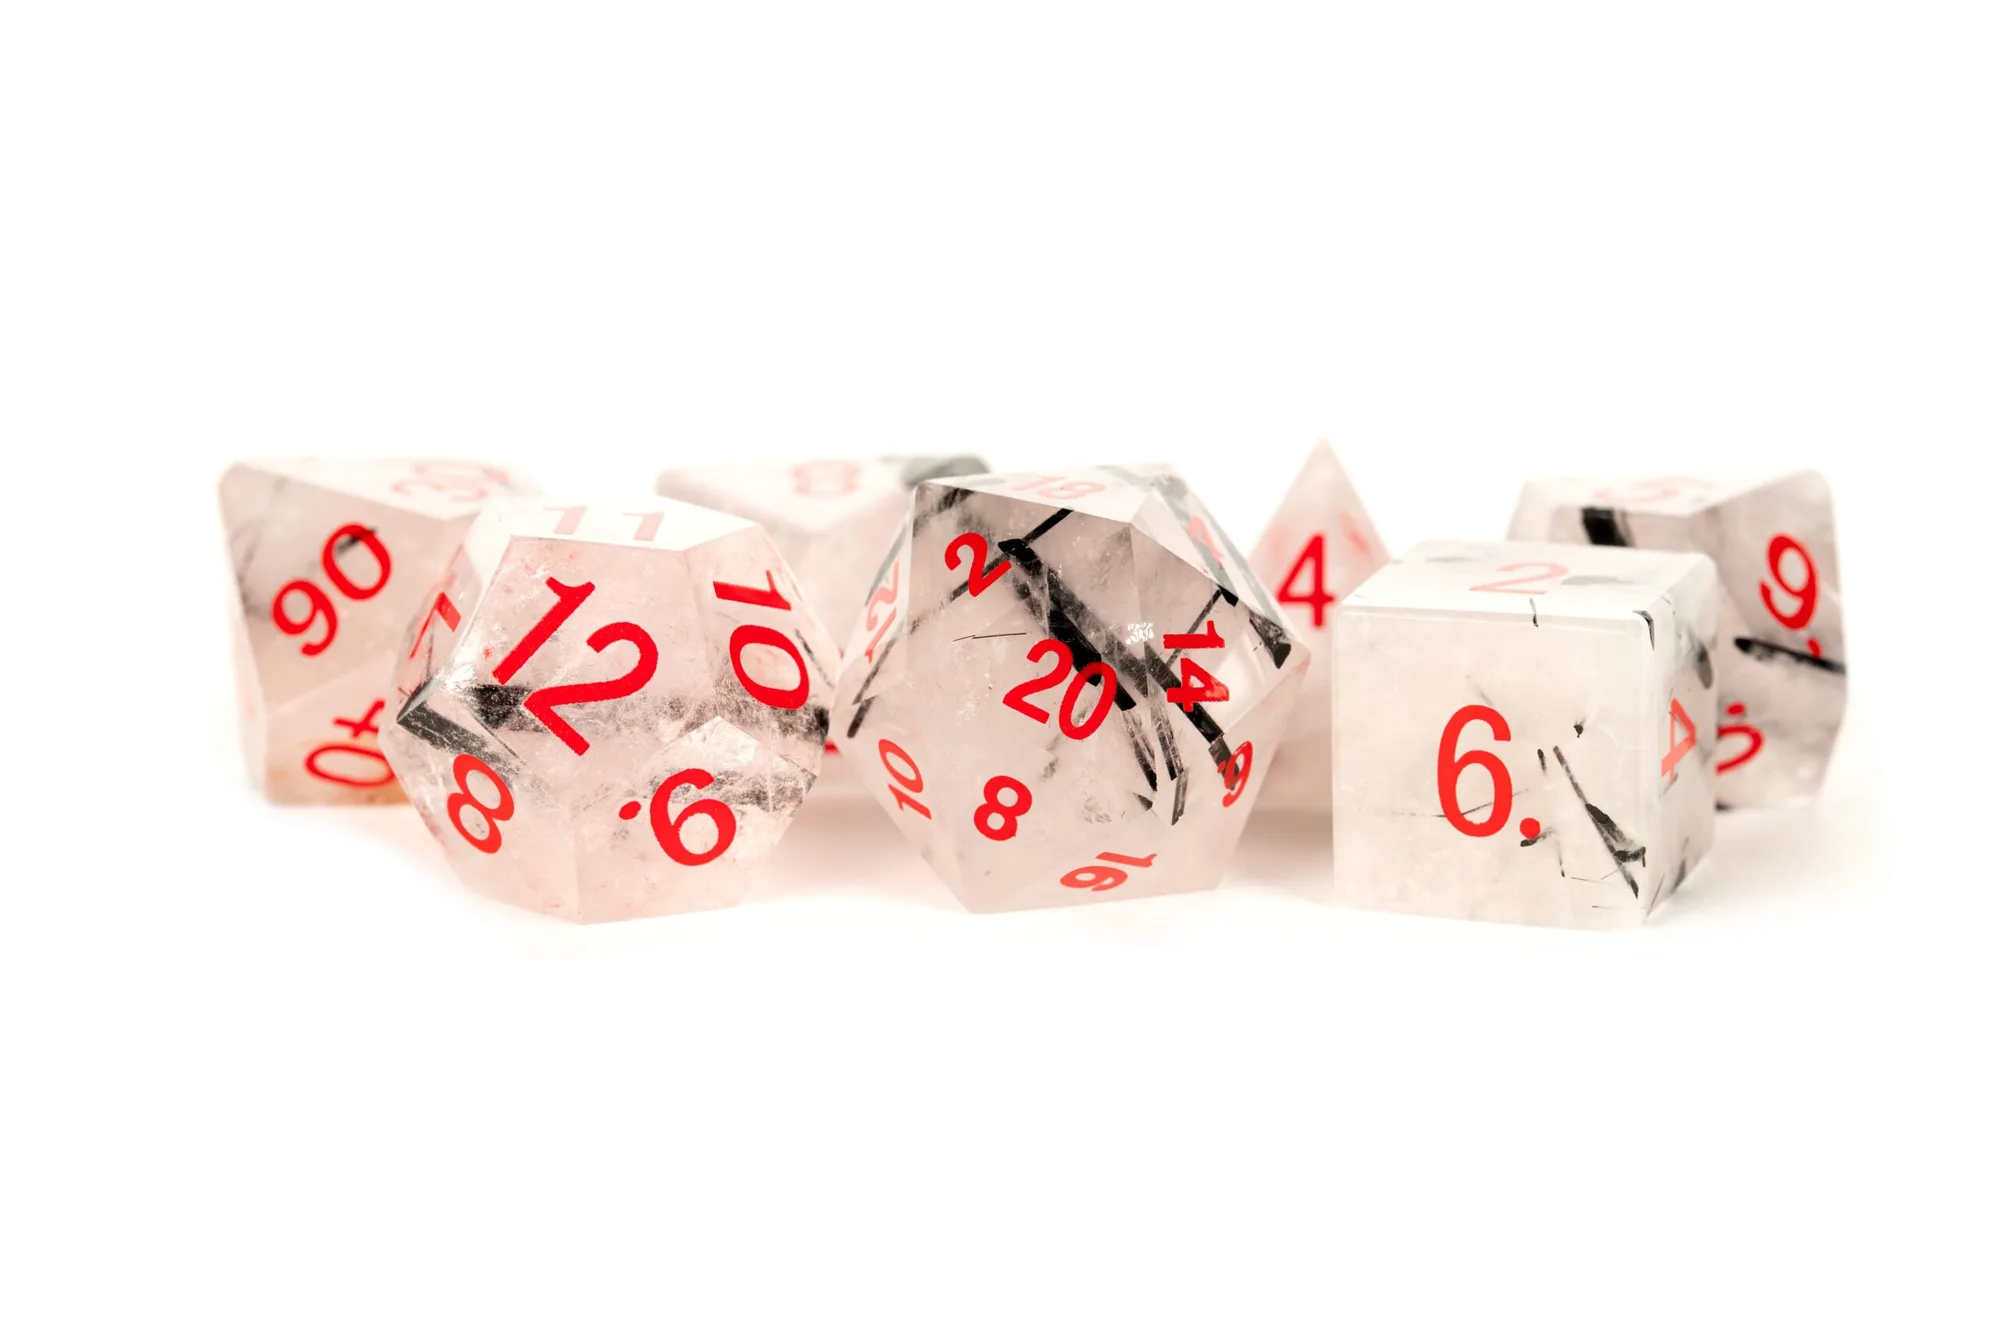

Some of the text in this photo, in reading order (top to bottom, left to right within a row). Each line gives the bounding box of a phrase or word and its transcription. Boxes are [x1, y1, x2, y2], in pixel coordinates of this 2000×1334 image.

[542, 505, 664, 541] 11
[945, 532, 1011, 597] 2
[270, 522, 393, 658] 90
[1275, 533, 1336, 628] 4
[1469, 562, 1568, 594] 2
[492, 577, 658, 756] 12
[714, 572, 809, 710] 10
[1163, 620, 1229, 712] 14
[1003, 639, 1117, 740] 20
[878, 739, 932, 820] 10
[1662, 698, 1697, 784] 4
[450, 754, 514, 854] 8
[973, 775, 1032, 841] 8
[1060, 852, 1157, 891] 16
